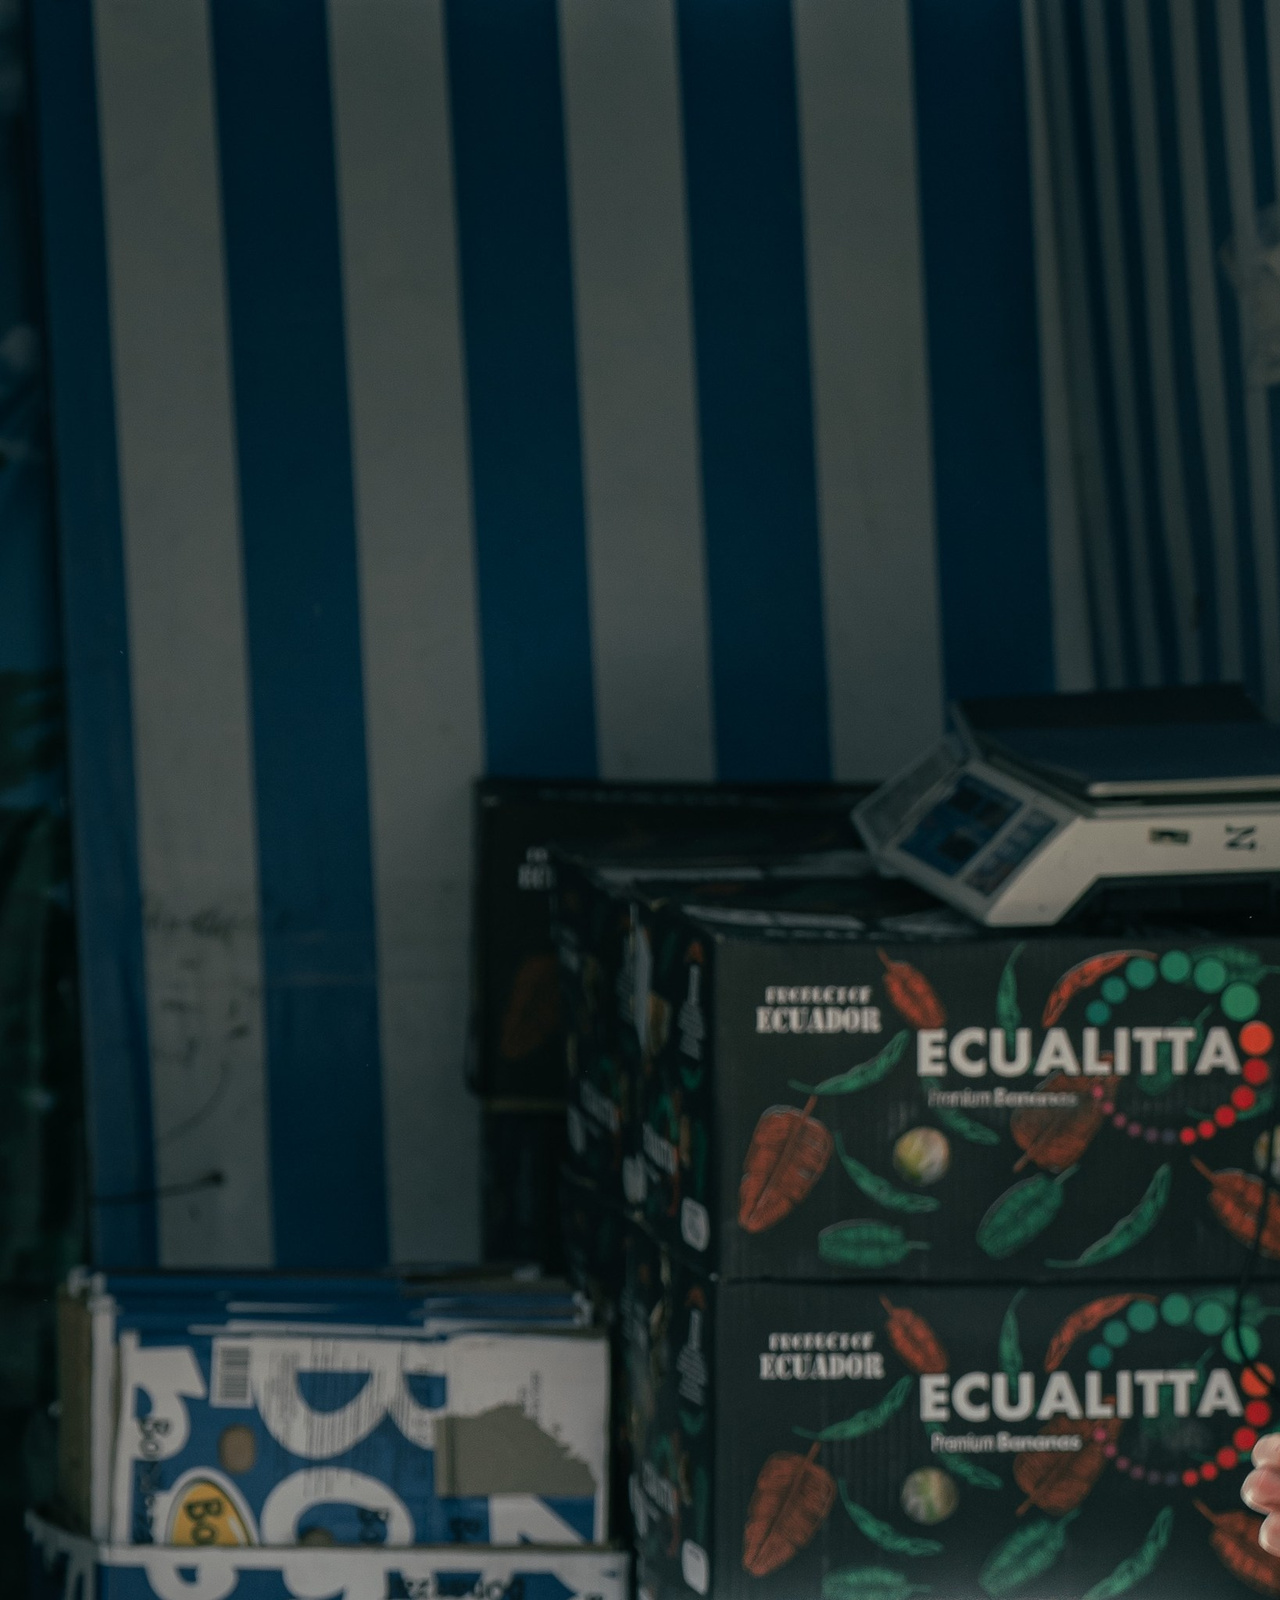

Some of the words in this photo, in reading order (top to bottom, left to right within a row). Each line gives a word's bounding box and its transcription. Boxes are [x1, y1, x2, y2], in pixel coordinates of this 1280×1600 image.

[756, 1006, 883, 1034] ECUADOR
[916, 1027, 1241, 1077] ECUALITTA
[993, 1087, 1079, 1107] Bananas
[759, 1352, 886, 1380] ECUADOR
[919, 1370, 1242, 1422] ECUALITTA
[931, 1431, 992, 1454] Premium
[994, 1431, 1082, 1453] Bananas
